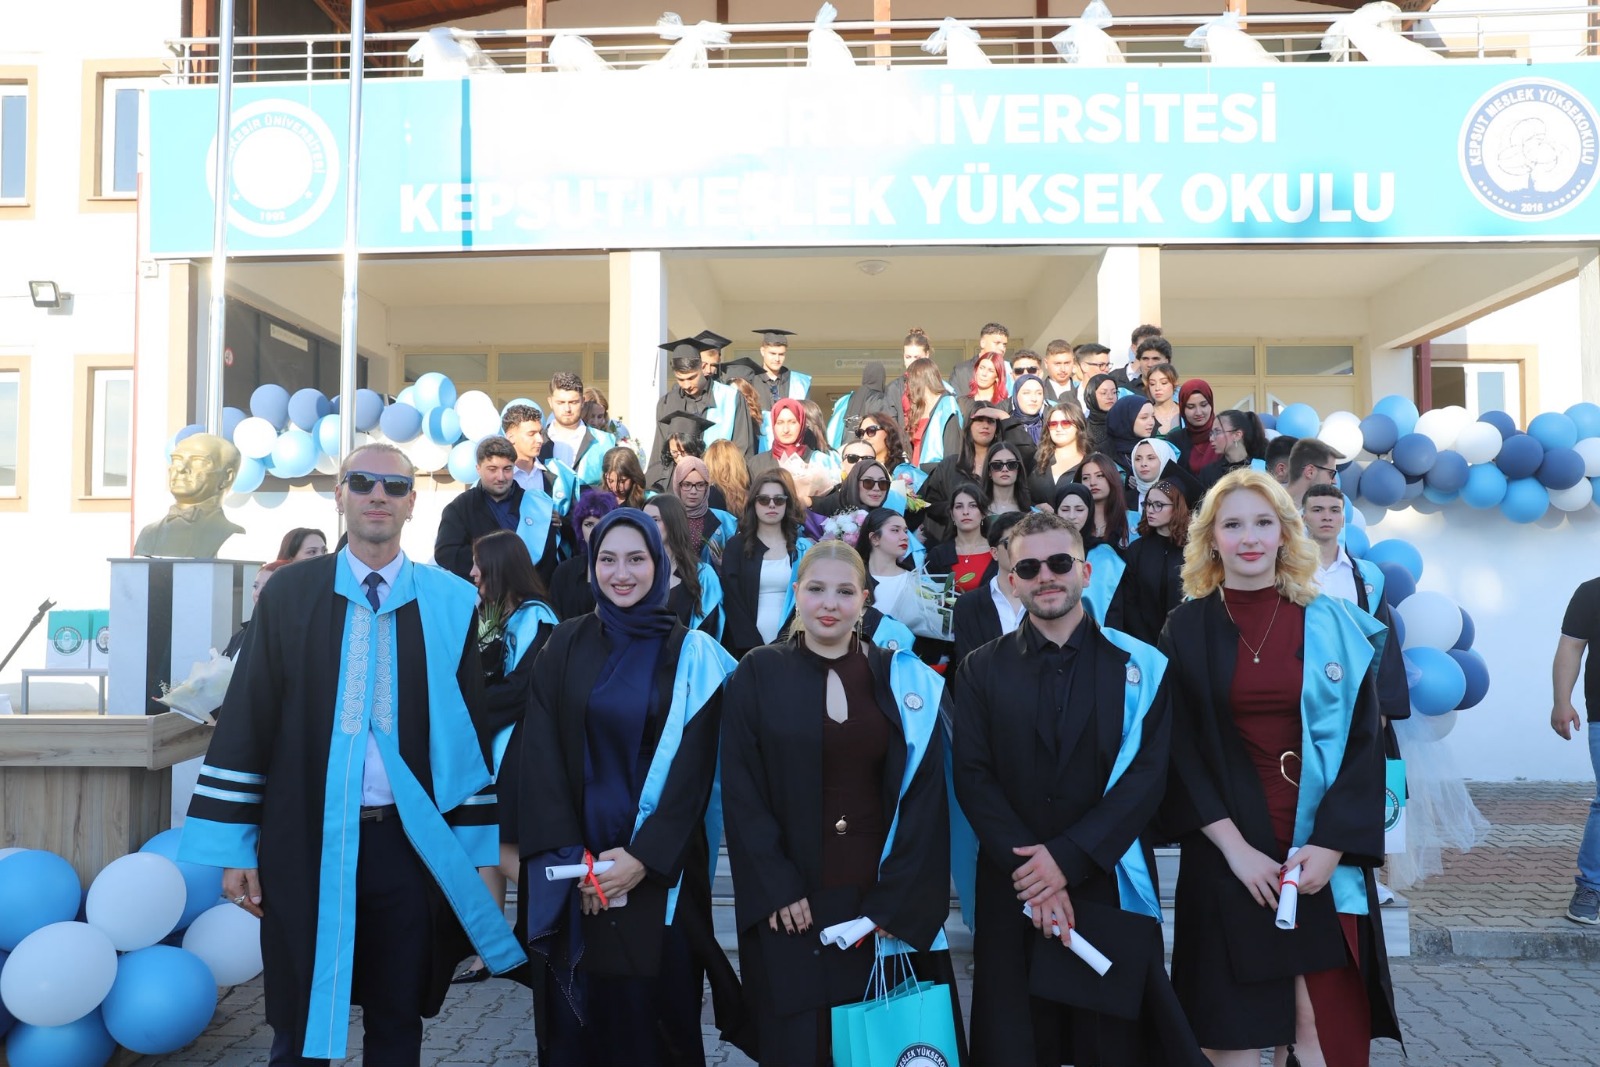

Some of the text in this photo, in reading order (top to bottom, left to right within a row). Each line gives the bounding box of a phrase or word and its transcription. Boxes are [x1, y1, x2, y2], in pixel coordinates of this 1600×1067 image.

[1469, 89, 1595, 166] KEPSUT MESLEK YÜKSEKOKULU
[400, 178, 634, 233] KEPSUT
[911, 162, 1165, 225] YÜKSEK
[1180, 172, 1395, 223] OKULU
[897, 1047, 946, 1067] ESLEK YÜKSEKO
